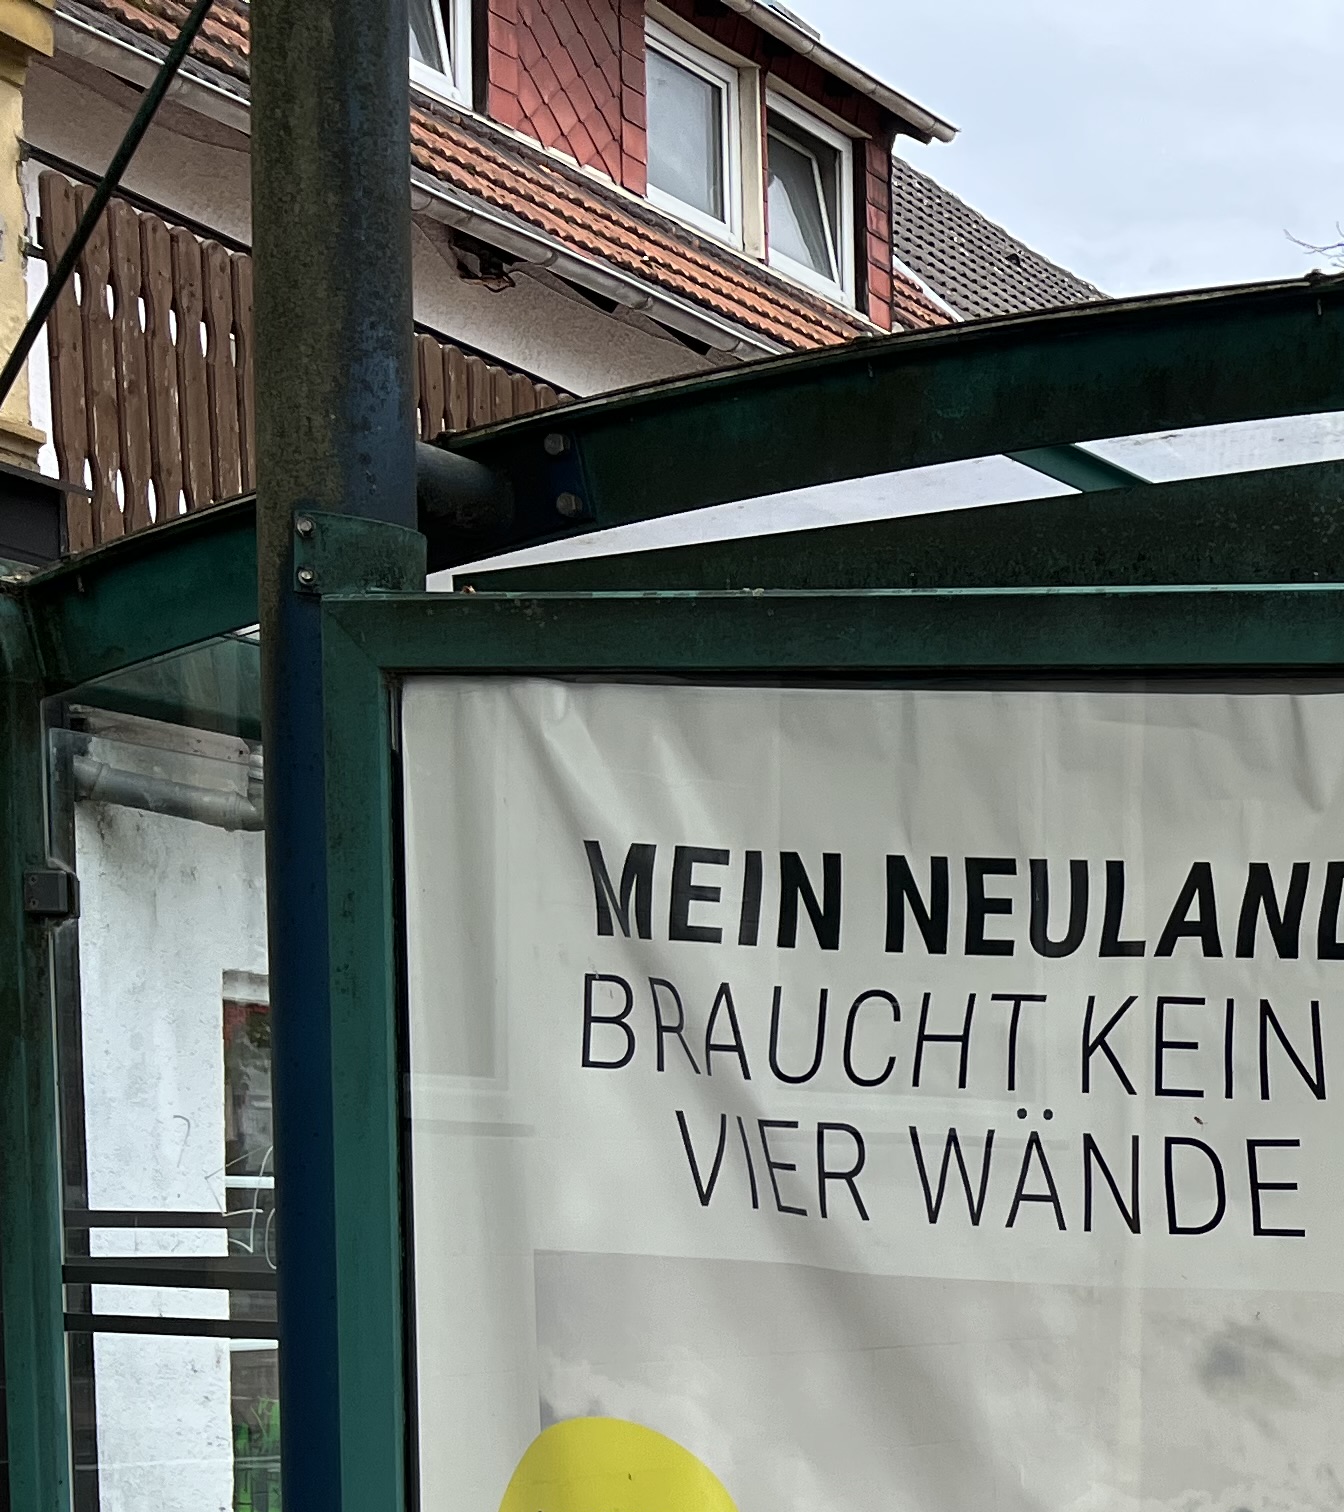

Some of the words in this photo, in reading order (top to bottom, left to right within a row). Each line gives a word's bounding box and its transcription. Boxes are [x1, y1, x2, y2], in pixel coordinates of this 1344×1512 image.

[583, 840, 842, 951] MEIN
[581, 973, 1048, 1091] BRAUCHT
[675, 1110, 870, 1221] VIER
[909, 1107, 1306, 1238] WÄNDE
